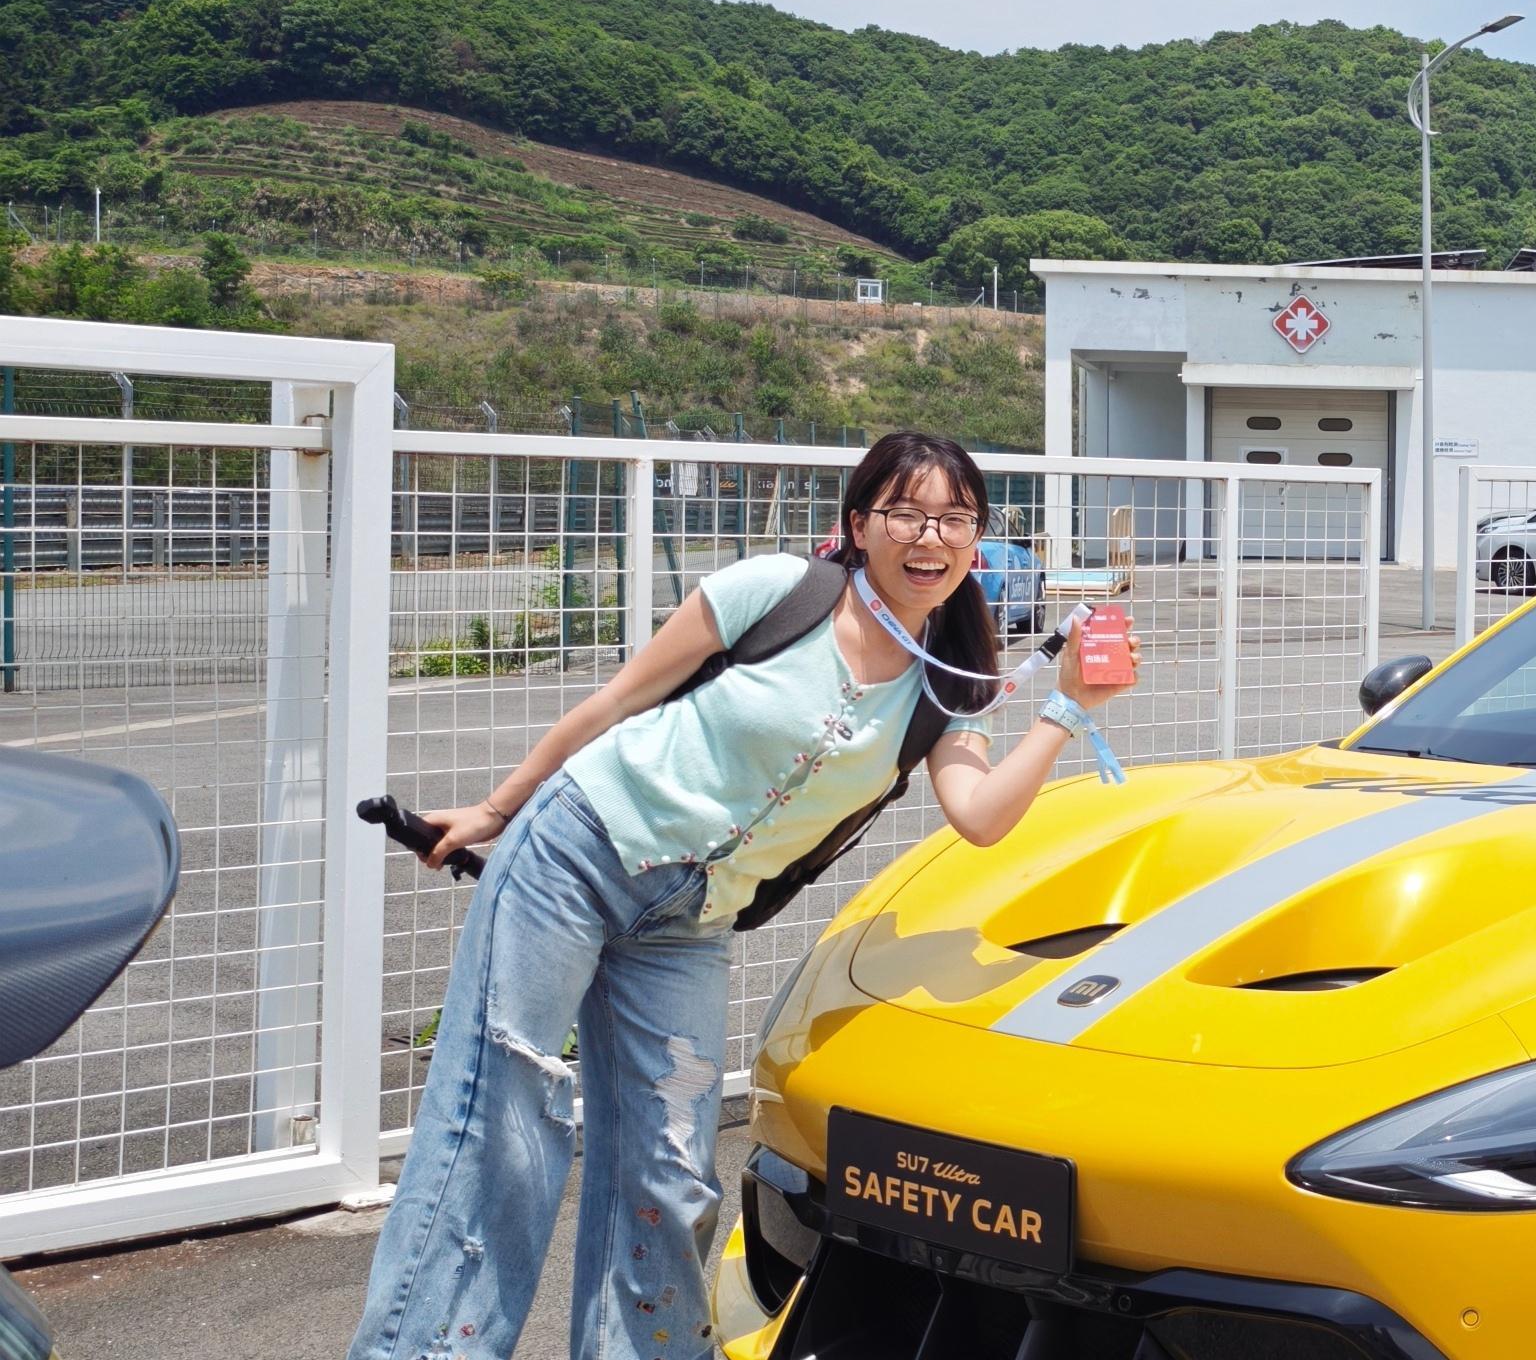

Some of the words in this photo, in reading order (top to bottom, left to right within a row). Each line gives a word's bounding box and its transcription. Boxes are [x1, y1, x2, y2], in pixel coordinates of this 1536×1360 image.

[897, 1151, 929, 1173] SU7
[932, 1161, 981, 1185] Ultra
[844, 1165, 962, 1222] SAFETY
[972, 1198, 1043, 1244] CAR
